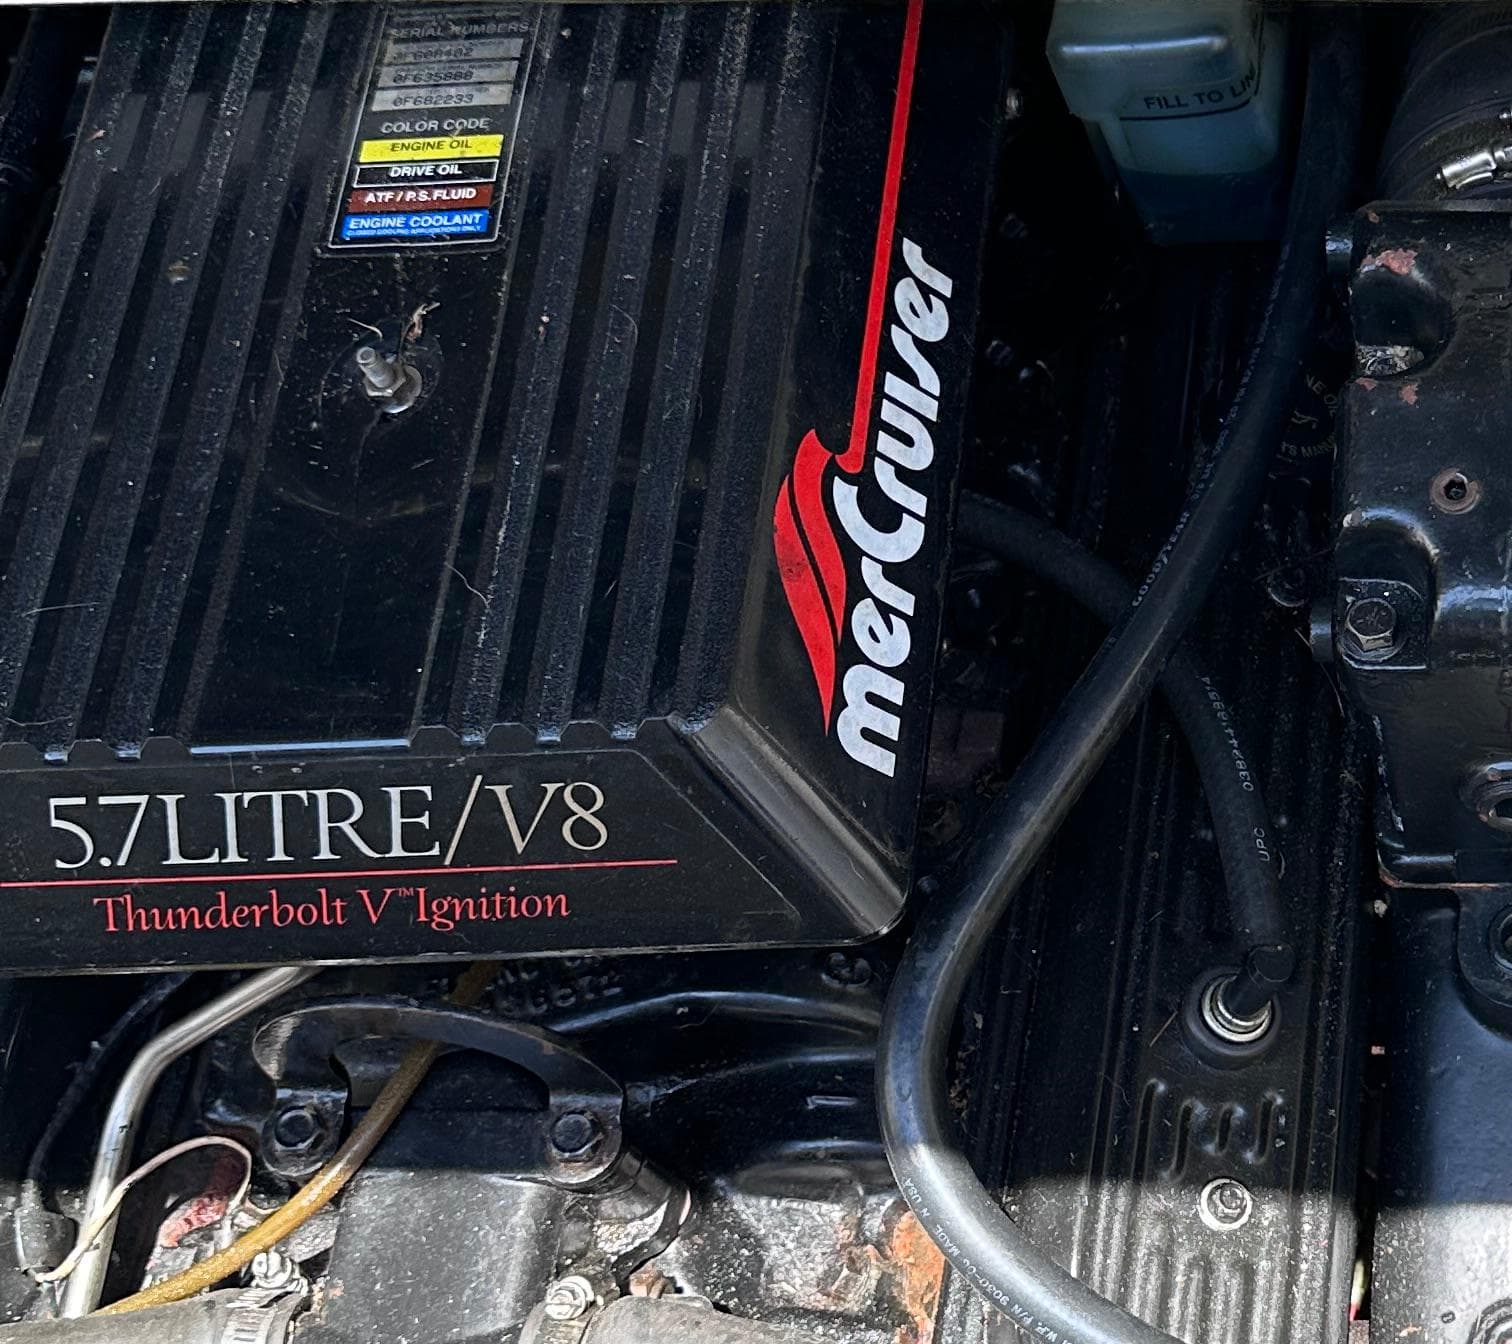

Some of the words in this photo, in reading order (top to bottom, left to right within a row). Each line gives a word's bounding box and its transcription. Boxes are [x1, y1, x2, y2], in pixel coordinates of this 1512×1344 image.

[1144, 94, 1189, 110] FILL
[1195, 89, 1224, 106] TO
[381, 119, 439, 134] COLOR
[443, 117, 491, 131] CODE
[390, 141, 444, 153] ENGINE
[449, 139, 473, 150] OIL
[389, 166, 436, 178] DRIVE
[436, 164, 463, 176] OIL
[363, 191, 398, 204] ATF
[349, 215, 406, 230] ENGINE
[409, 213, 483, 229] COOLANT
[93, 888, 347, 933] Thunderbolt
[904, 1177, 923, 1204] USA
